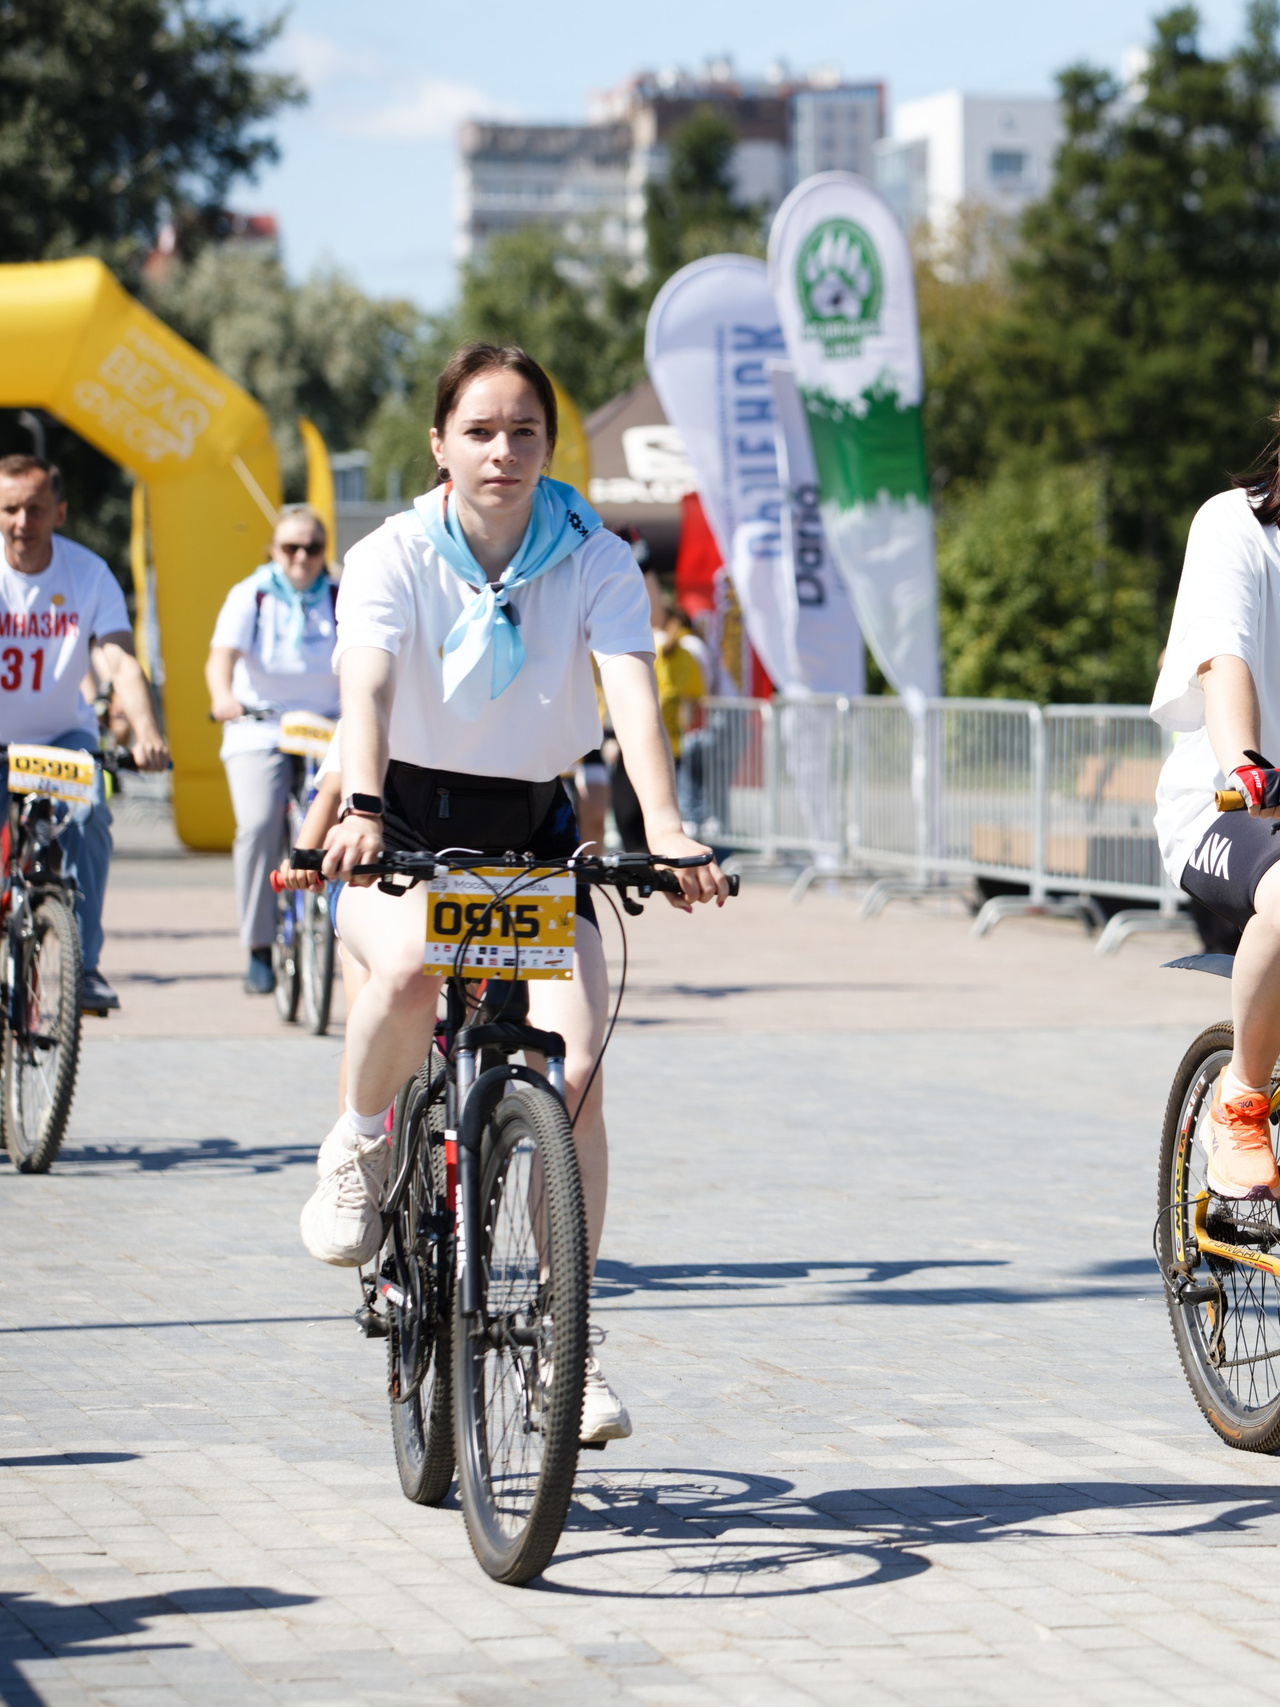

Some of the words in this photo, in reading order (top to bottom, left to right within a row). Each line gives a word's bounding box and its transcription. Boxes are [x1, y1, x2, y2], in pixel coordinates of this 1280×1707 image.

[1, 646, 44, 692] 31
[15, 757, 79, 779] 0599
[434, 901, 540, 938] 0915
[1234, 1100, 1254, 1108] OKA
